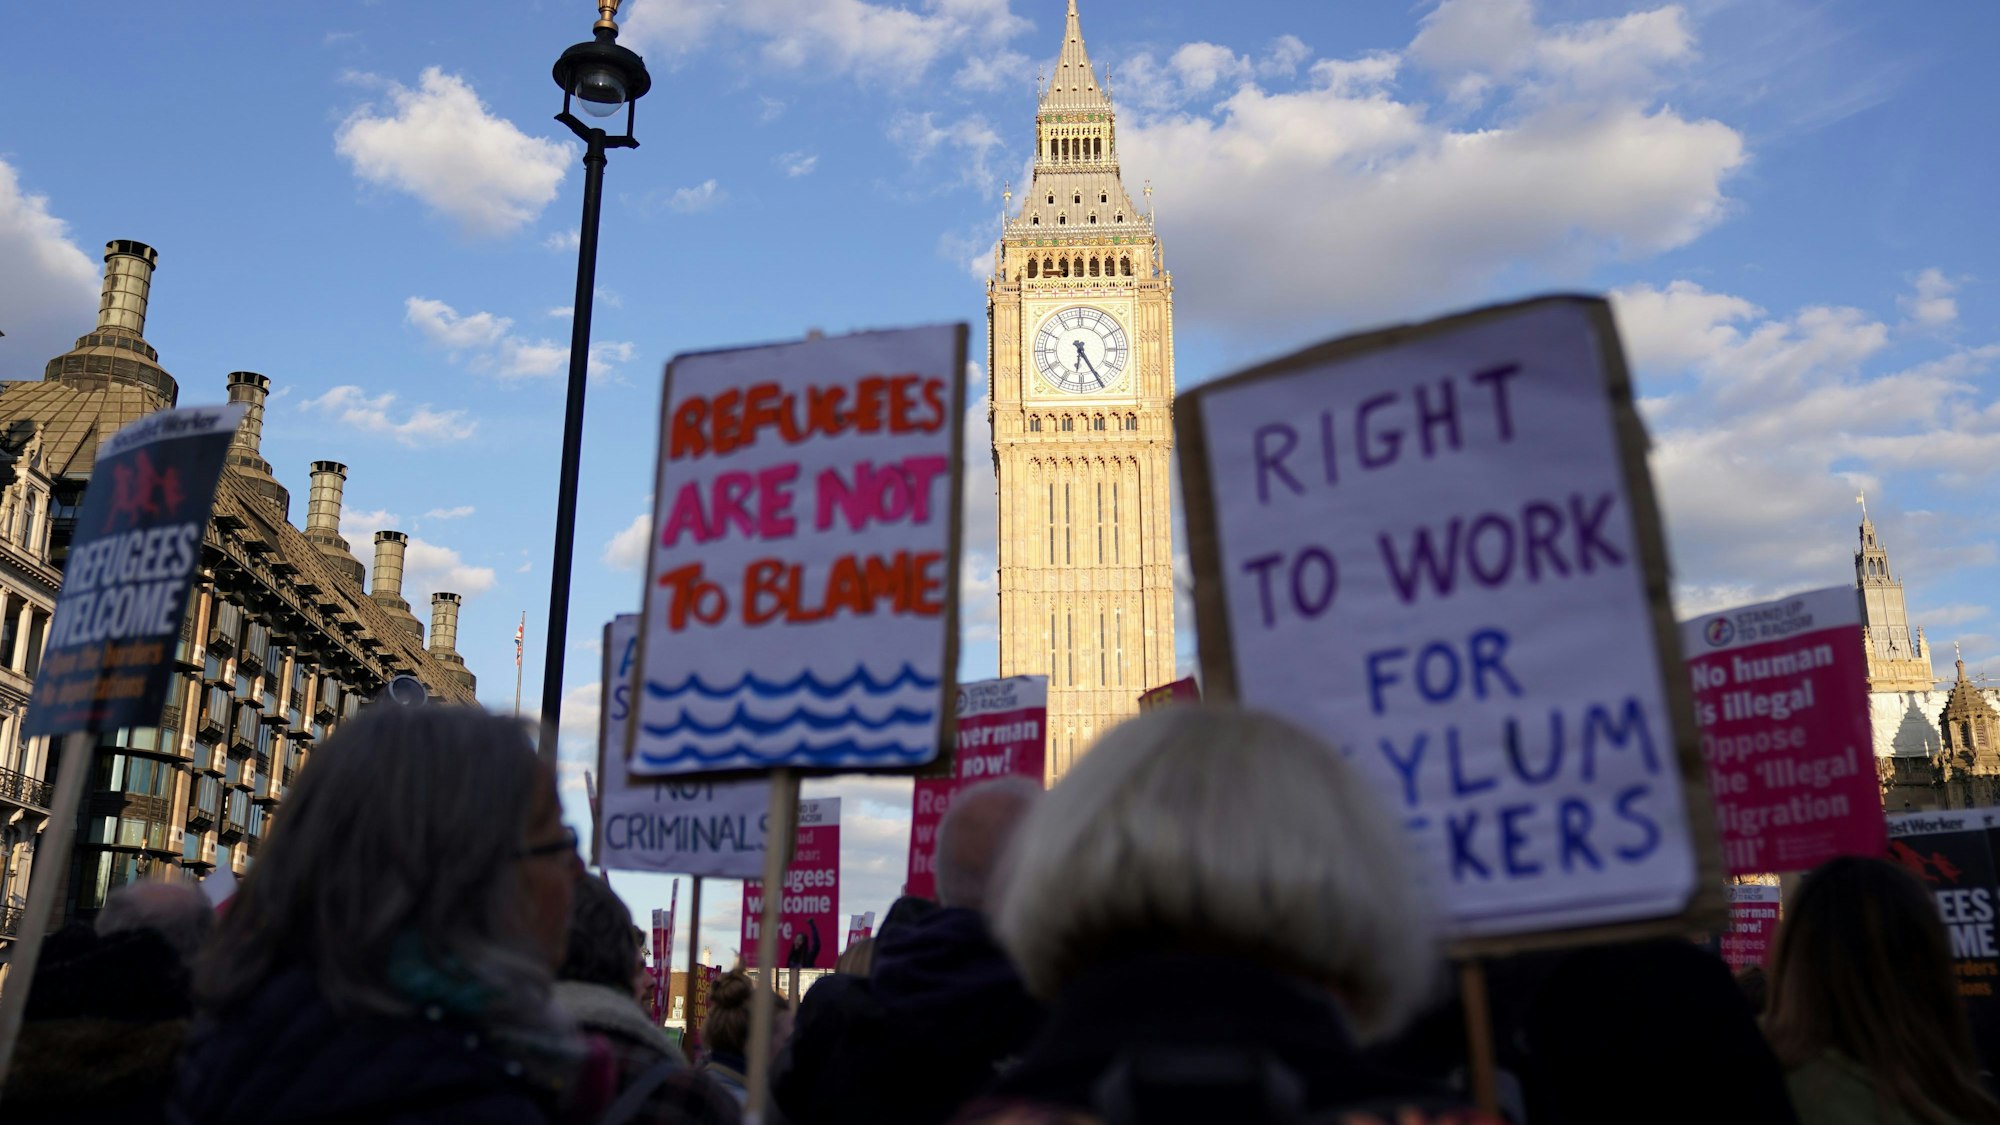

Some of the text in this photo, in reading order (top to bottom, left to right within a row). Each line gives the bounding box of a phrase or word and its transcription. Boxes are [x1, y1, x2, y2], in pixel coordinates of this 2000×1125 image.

[668, 373, 947, 462] REFUGEES
[1252, 361, 1522, 504] RIGHT
[661, 456, 949, 549] ARE NOT
[66, 523, 197, 594] REFUGEES
[741, 550, 946, 627] BLAME
[1242, 492, 1628, 628] TO WORK
[52, 580, 184, 649] WELCOME
[1365, 627, 1523, 717] FOR
[1691, 644, 1834, 693] No human
[1695, 679, 1815, 727] is illegal
[962, 748, 1012, 777] now!
[1378, 696, 1661, 809] YLUM
[1711, 769, 1748, 796] he
[801, 814, 822, 823] ACISM
[1909, 817, 1965, 834] Worker
[745, 916, 792, 940] hre
[747, 891, 831, 914] wlcome
